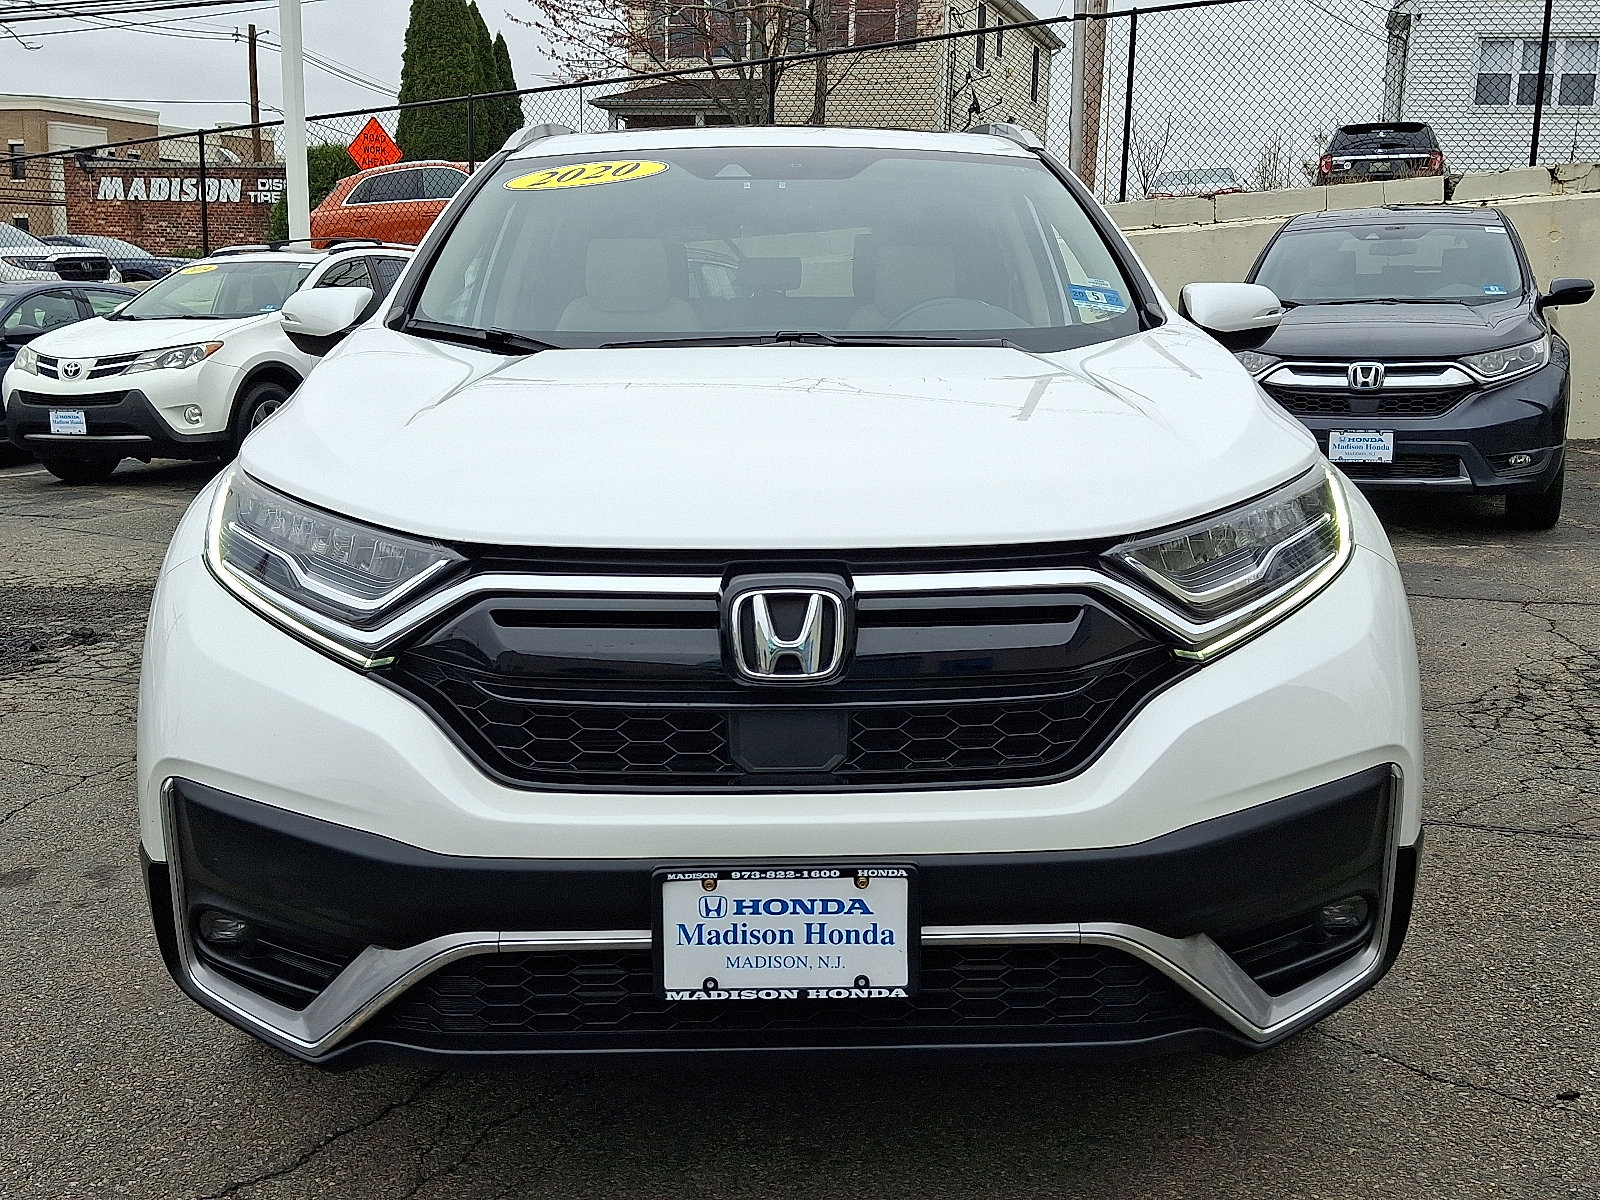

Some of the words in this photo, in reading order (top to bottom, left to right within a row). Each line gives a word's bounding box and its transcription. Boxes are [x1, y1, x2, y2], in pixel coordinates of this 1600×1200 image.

[364, 133, 386, 142] ROAD
[363, 145, 386, 155] WORK
[362, 157, 390, 166] AHEAD
[527, 162, 641, 188] 2020
[97, 177, 242, 203] MADISON
[246, 191, 281, 204] TIRE
[1091, 291, 1101, 301] 5
[1366, 443, 1390, 451] Honda
[666, 872, 718, 880] MADISON
[731, 869, 840, 880] 973-822-1600
[857, 869, 908, 877] HONDA
[732, 898, 875, 916] HONDA
[676, 922, 795, 946] Madison
[803, 922, 896, 946] Honda
[725, 956, 814, 971] MADISON,
[817, 956, 846, 969] N.J.
[665, 990, 799, 1001] MADISON
[806, 988, 909, 999] HONDA
